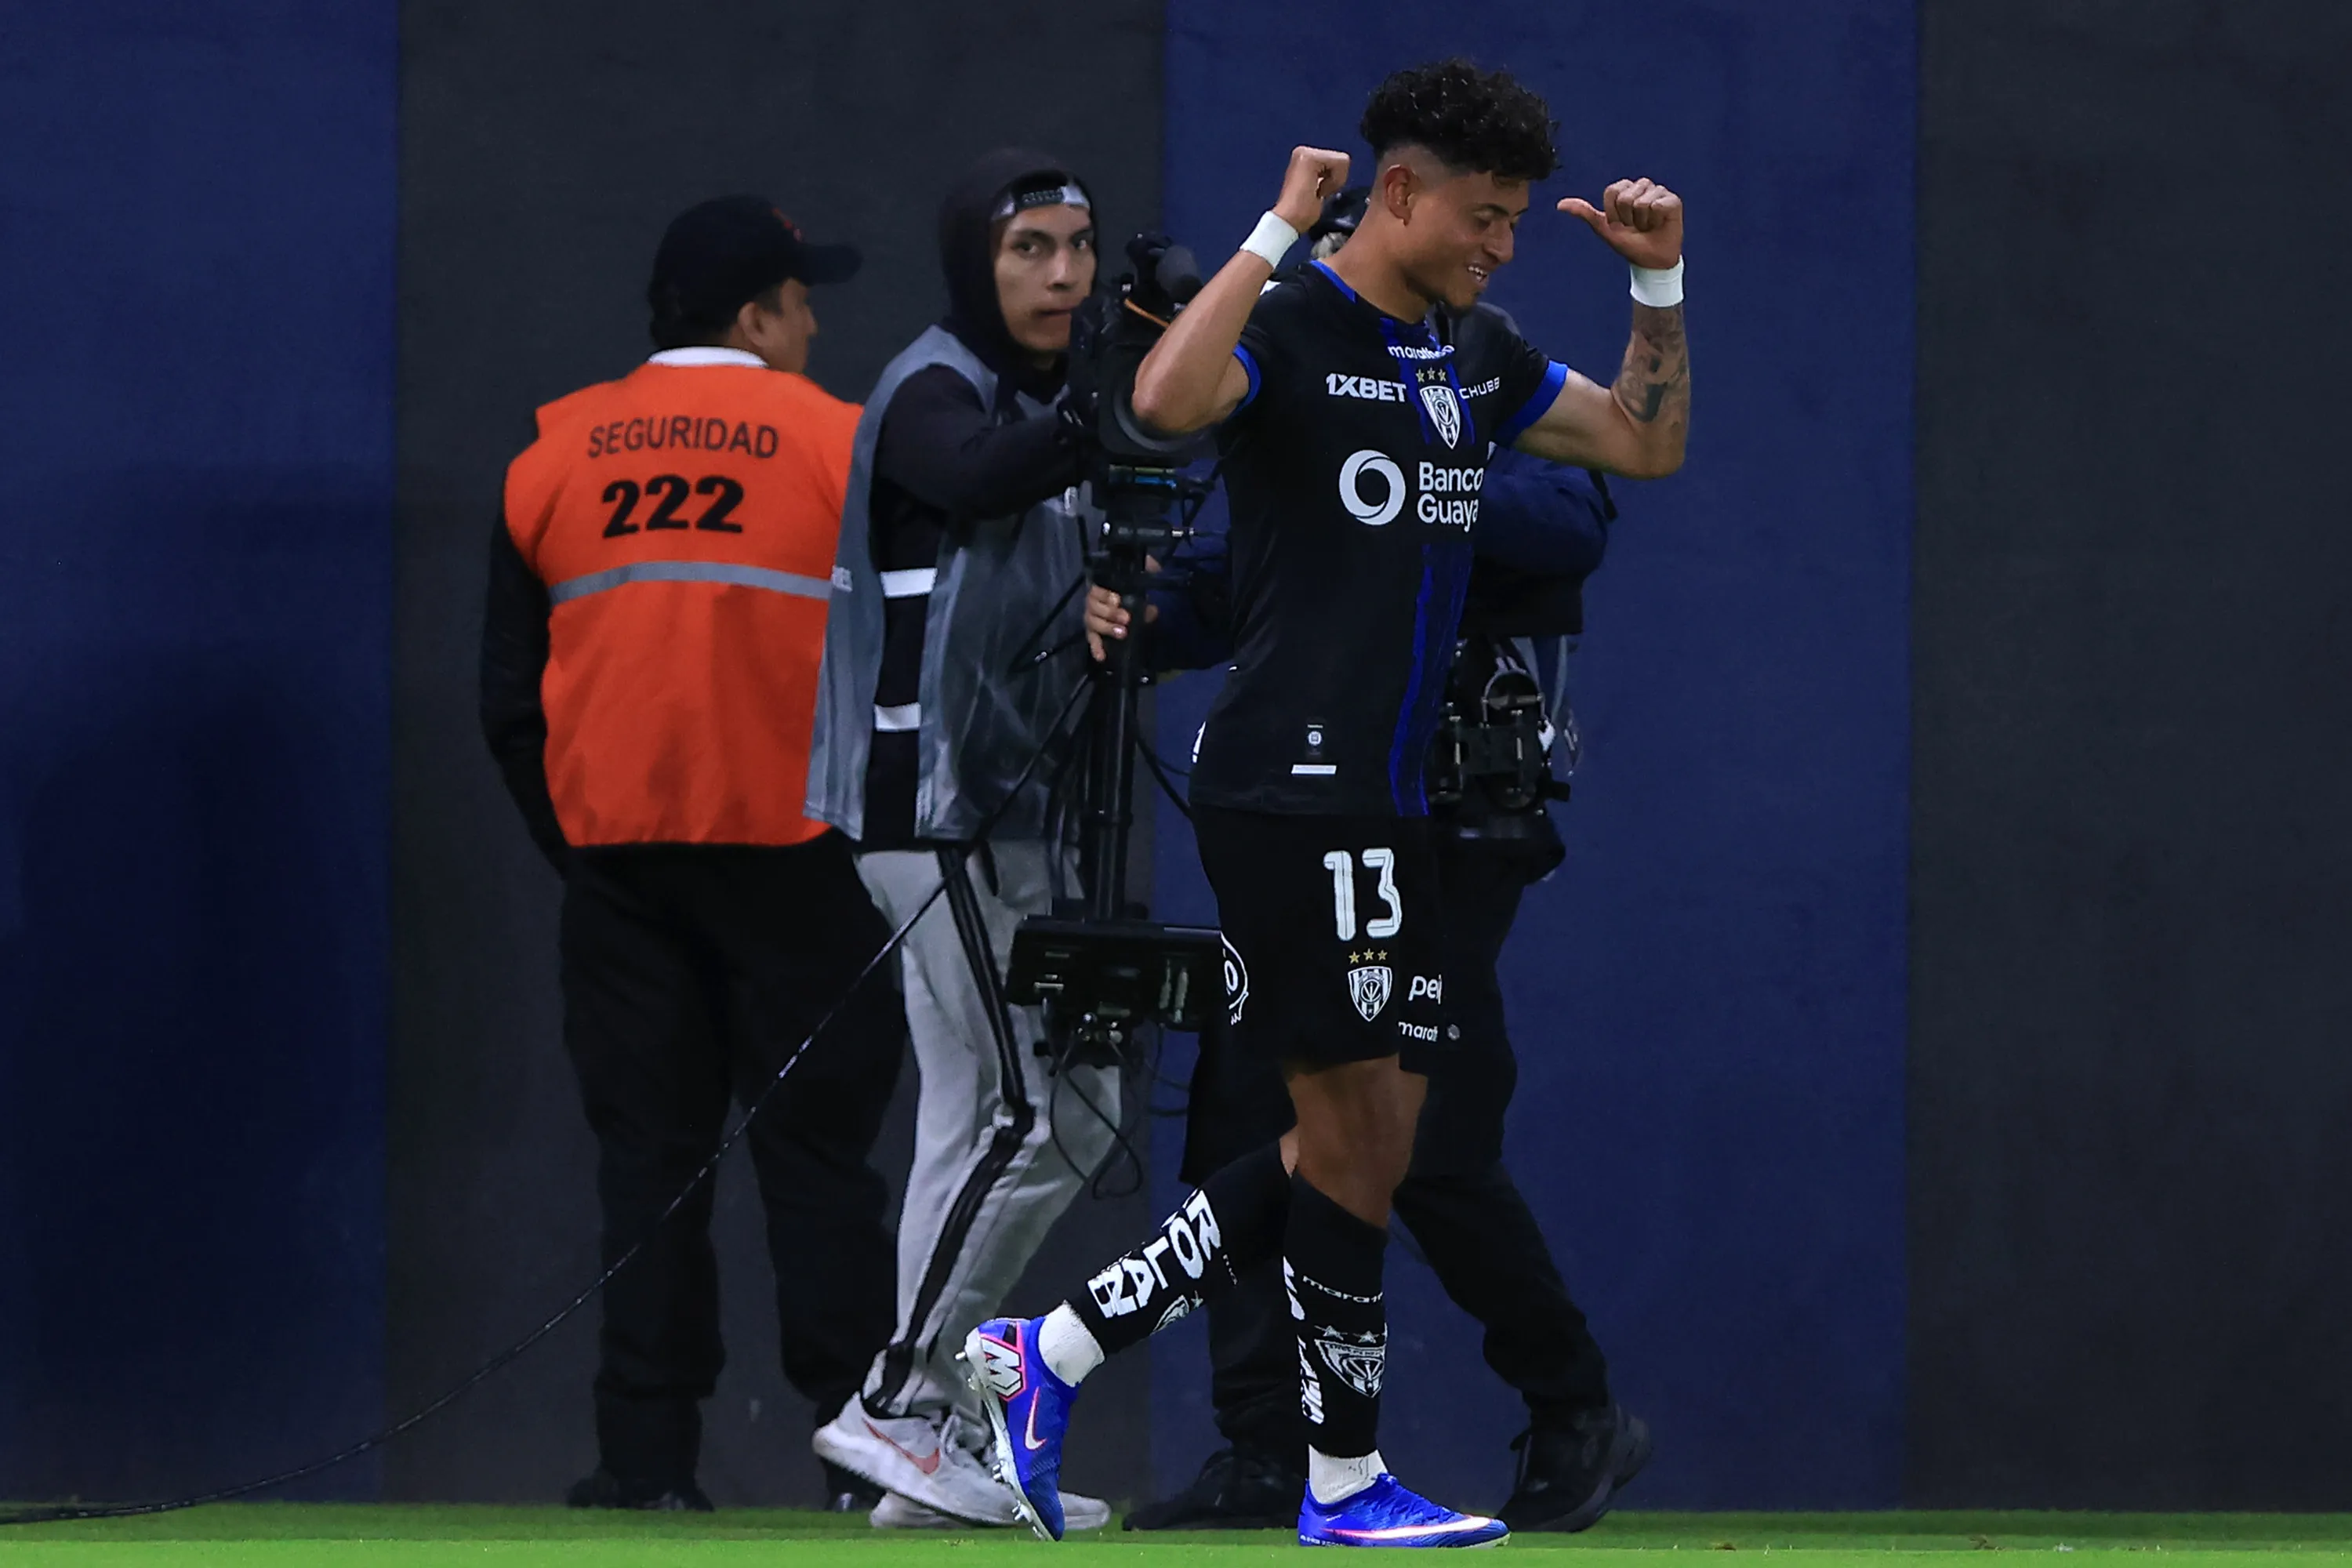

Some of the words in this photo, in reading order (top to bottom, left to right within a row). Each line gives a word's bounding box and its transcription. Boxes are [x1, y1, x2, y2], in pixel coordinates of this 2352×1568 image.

[1326, 372, 1407, 402] 1XBET
[1458, 376, 1500, 400] CHUBB
[586, 414, 779, 459] SEGURIDAD
[1419, 461, 1484, 492] Banco
[601, 474, 744, 539] 222
[1323, 847, 1403, 942] 13
